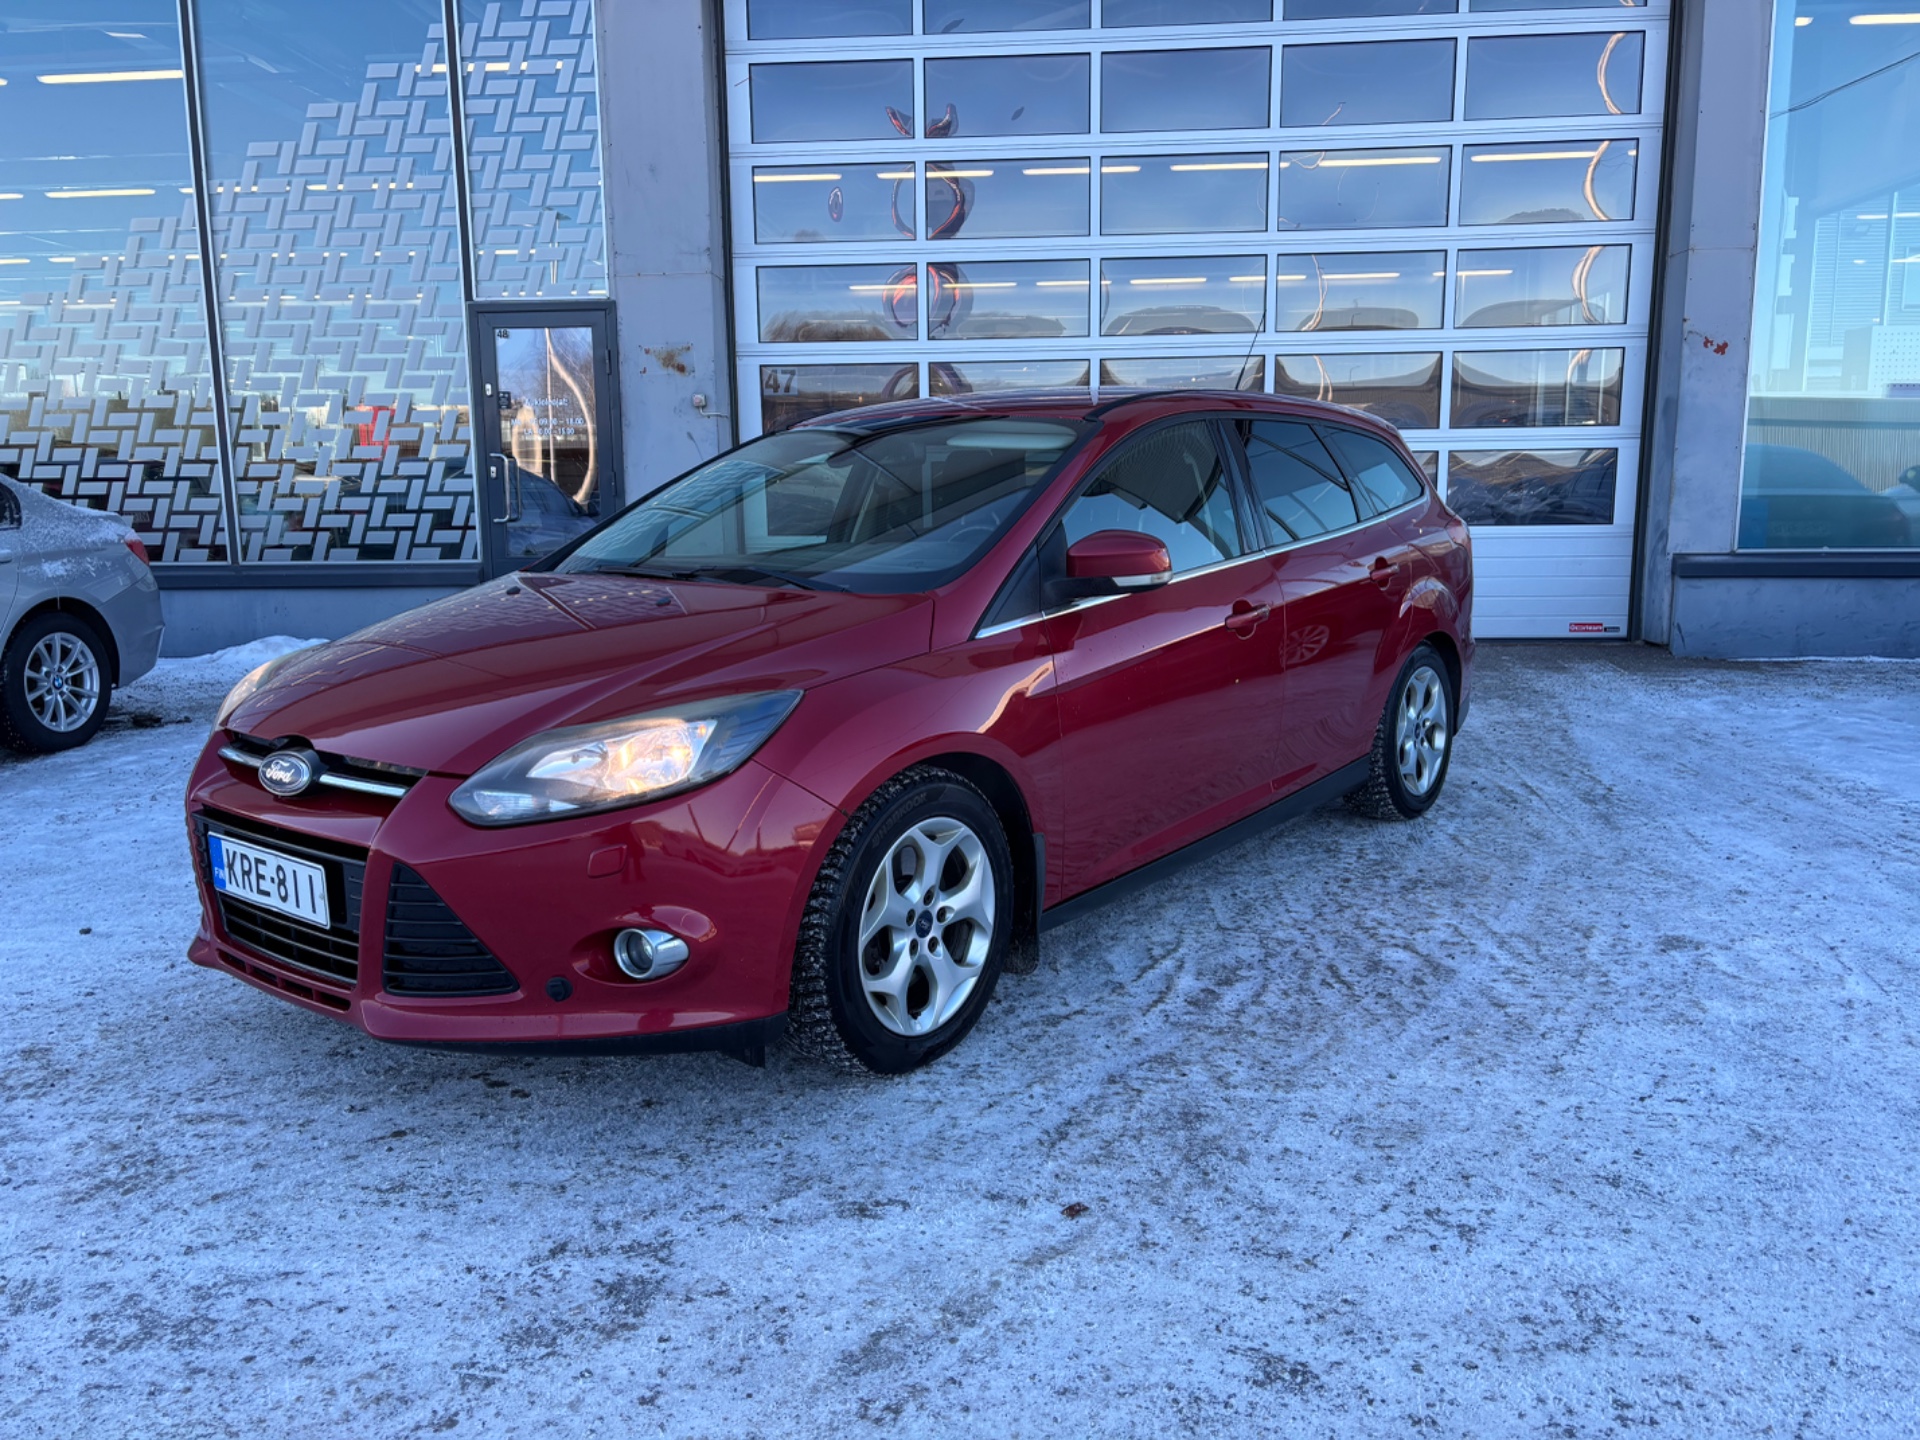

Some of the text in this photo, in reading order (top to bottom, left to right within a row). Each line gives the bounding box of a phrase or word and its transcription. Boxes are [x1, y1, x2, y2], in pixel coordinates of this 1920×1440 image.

[764, 369, 796, 393] 47
[265, 760, 295, 783] Ford
[225, 848, 317, 914] KRE-811
